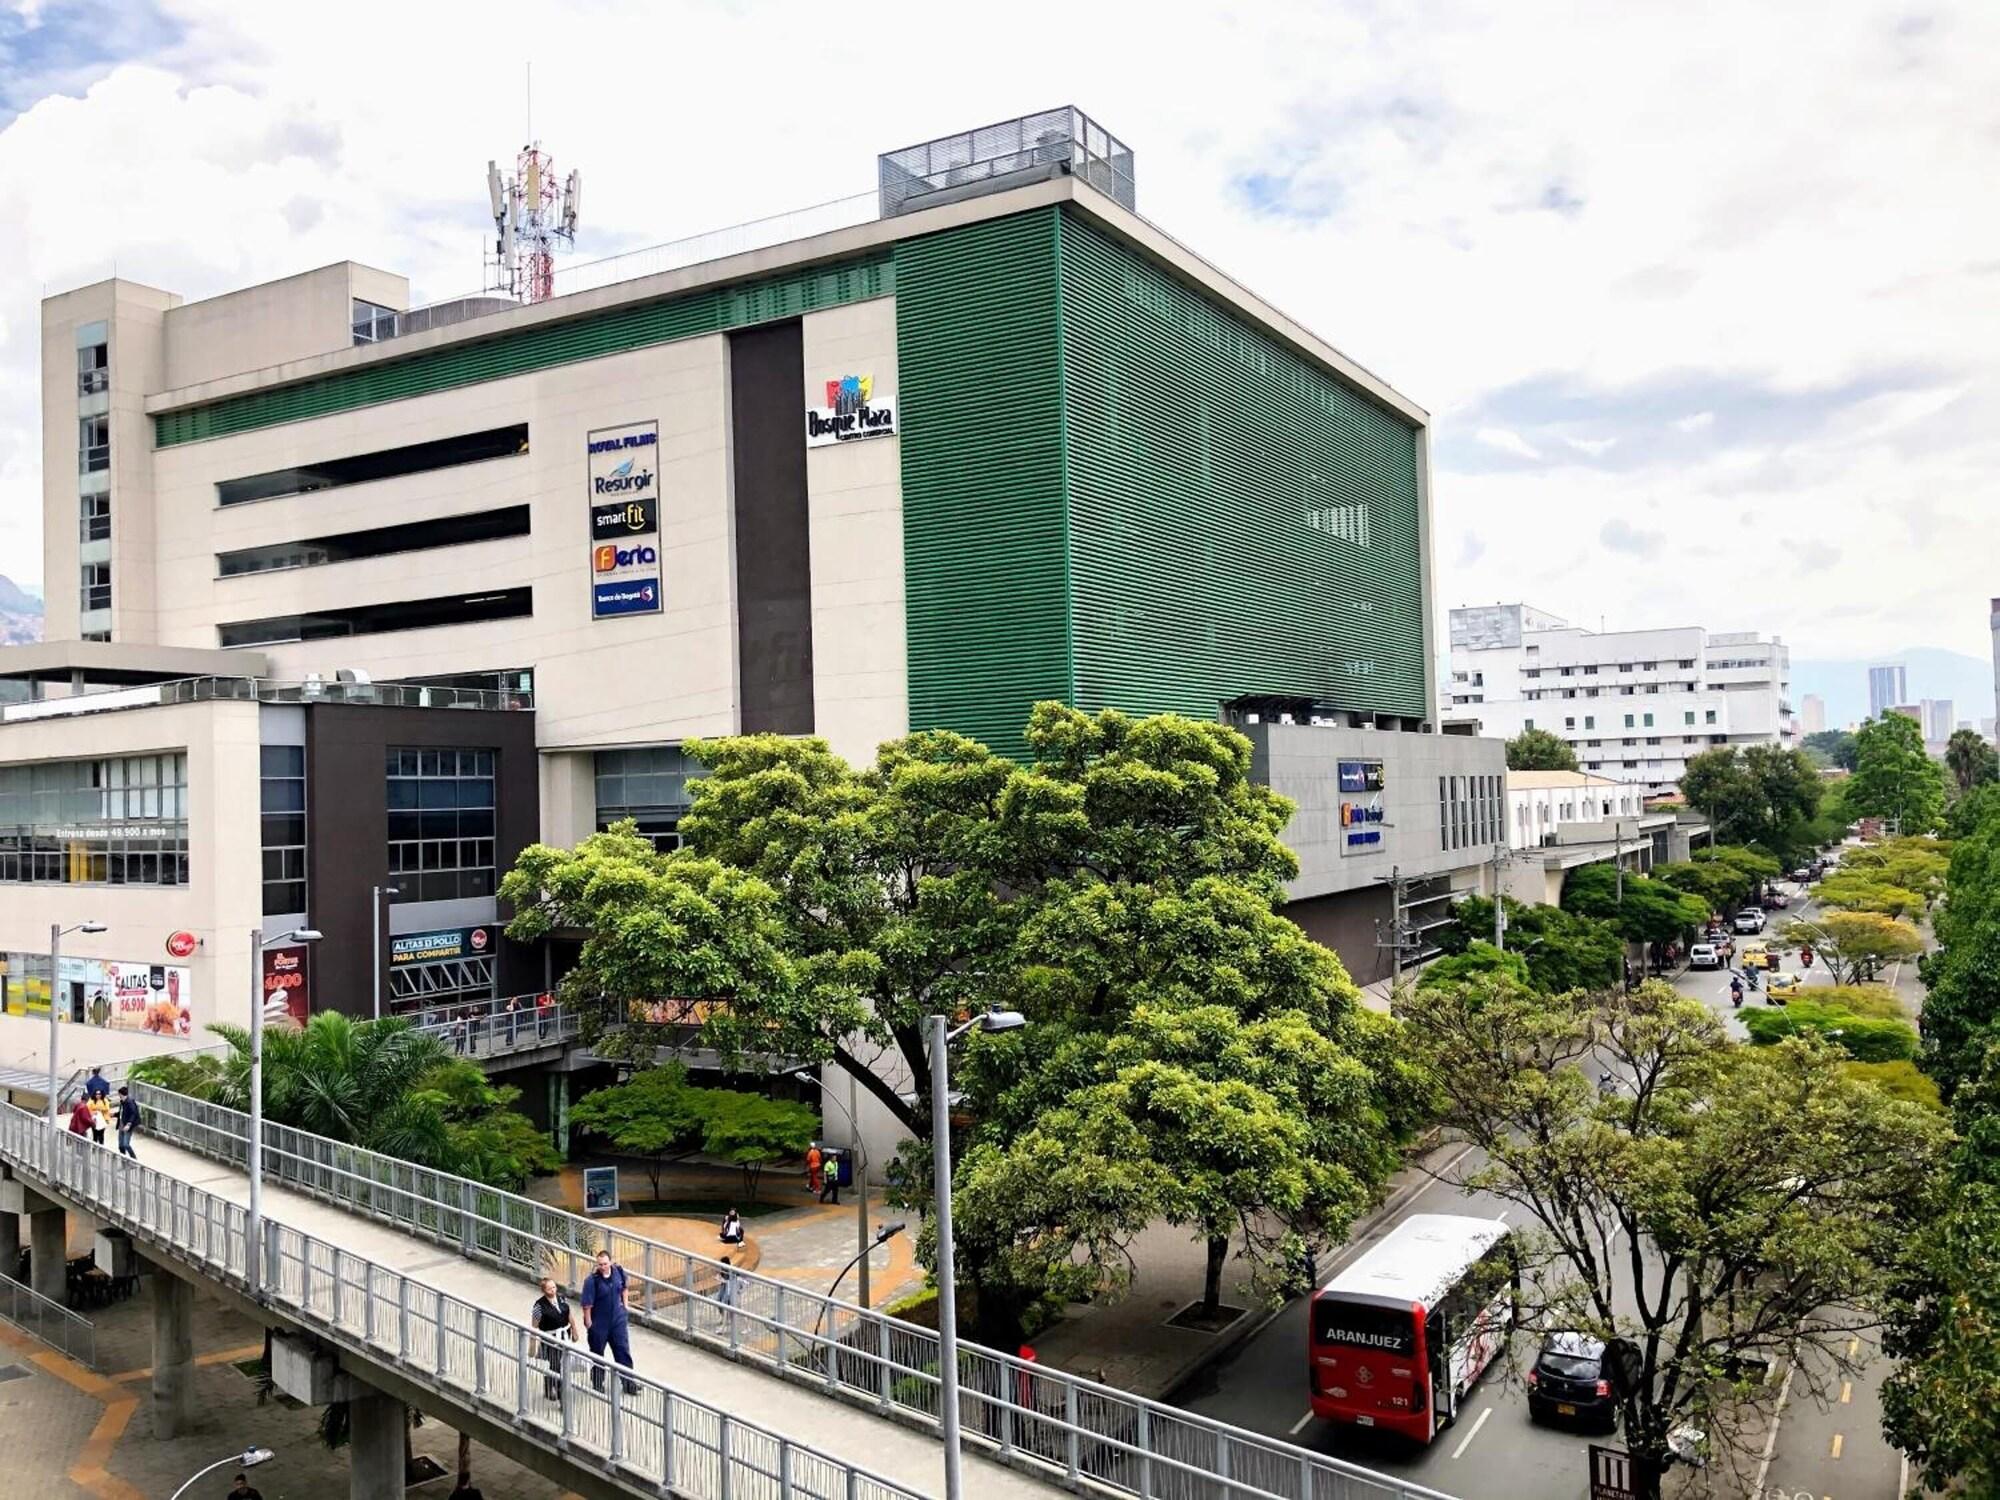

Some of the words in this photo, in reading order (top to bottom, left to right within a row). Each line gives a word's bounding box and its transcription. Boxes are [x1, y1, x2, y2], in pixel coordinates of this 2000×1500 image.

[808, 410, 855, 440] Bosque
[858, 406, 892, 428] Plaza
[595, 469, 653, 494] Resurgir
[596, 511, 626, 527] smart
[627, 504, 645, 523] fit
[394, 940, 424, 951] ALITAS
[433, 934, 461, 946] POLLO
[393, 952, 415, 962] PARA
[416, 947, 461, 959] COMPARTIR
[1326, 1328, 1401, 1348] ARANJUEZ
